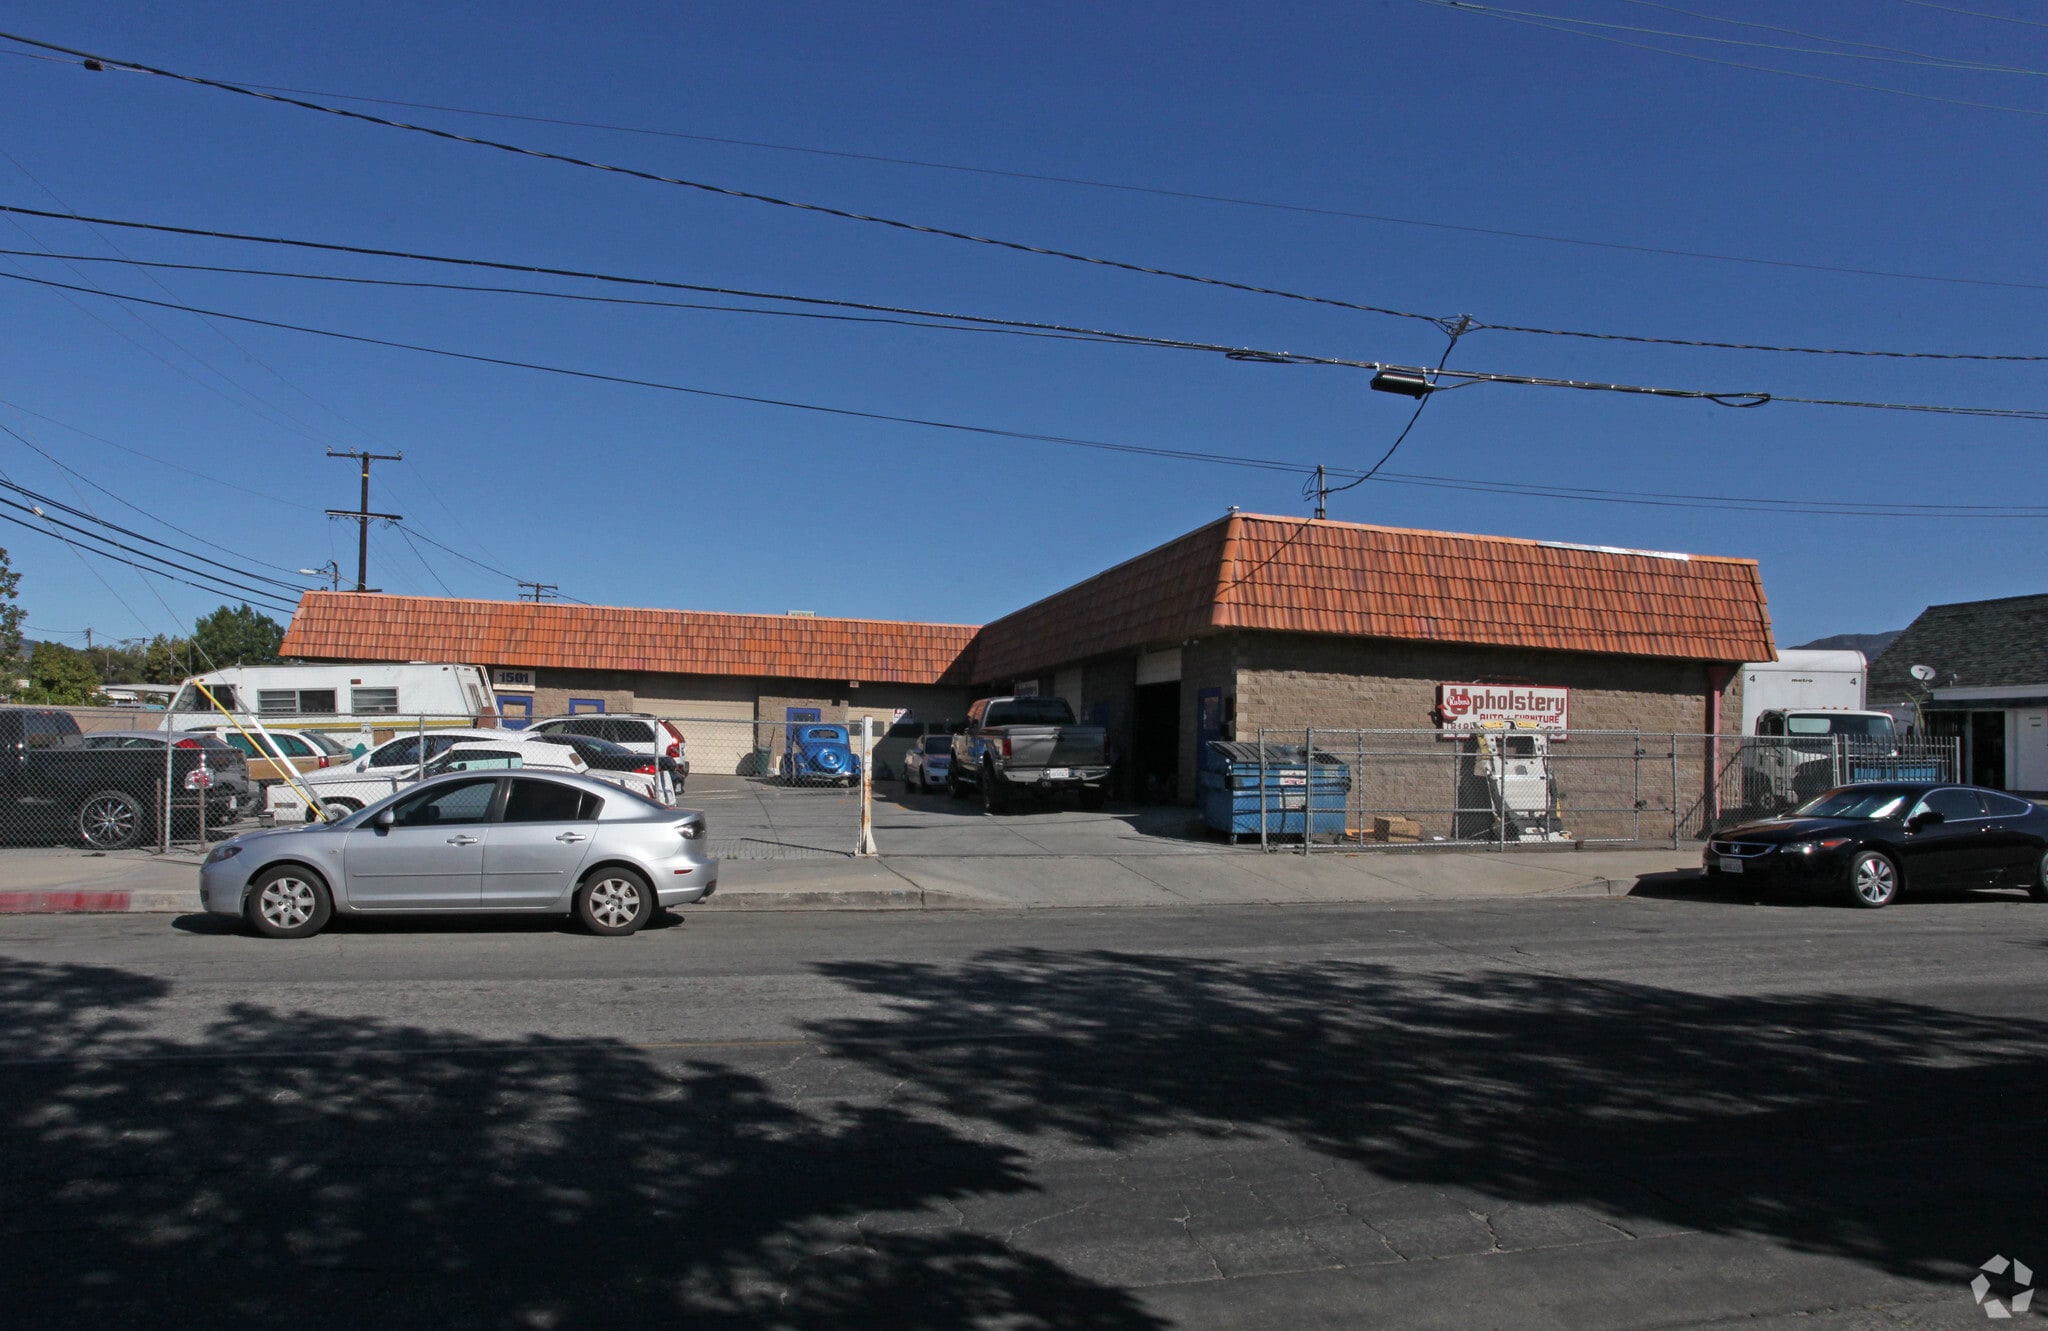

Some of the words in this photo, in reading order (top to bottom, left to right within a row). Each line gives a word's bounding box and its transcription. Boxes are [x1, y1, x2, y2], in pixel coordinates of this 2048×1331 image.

[499, 672, 529, 683] 1501
[1749, 674, 1756, 683] 4
[1850, 677, 1857, 686] 4
[1450, 688, 1565, 715] Upholstery
